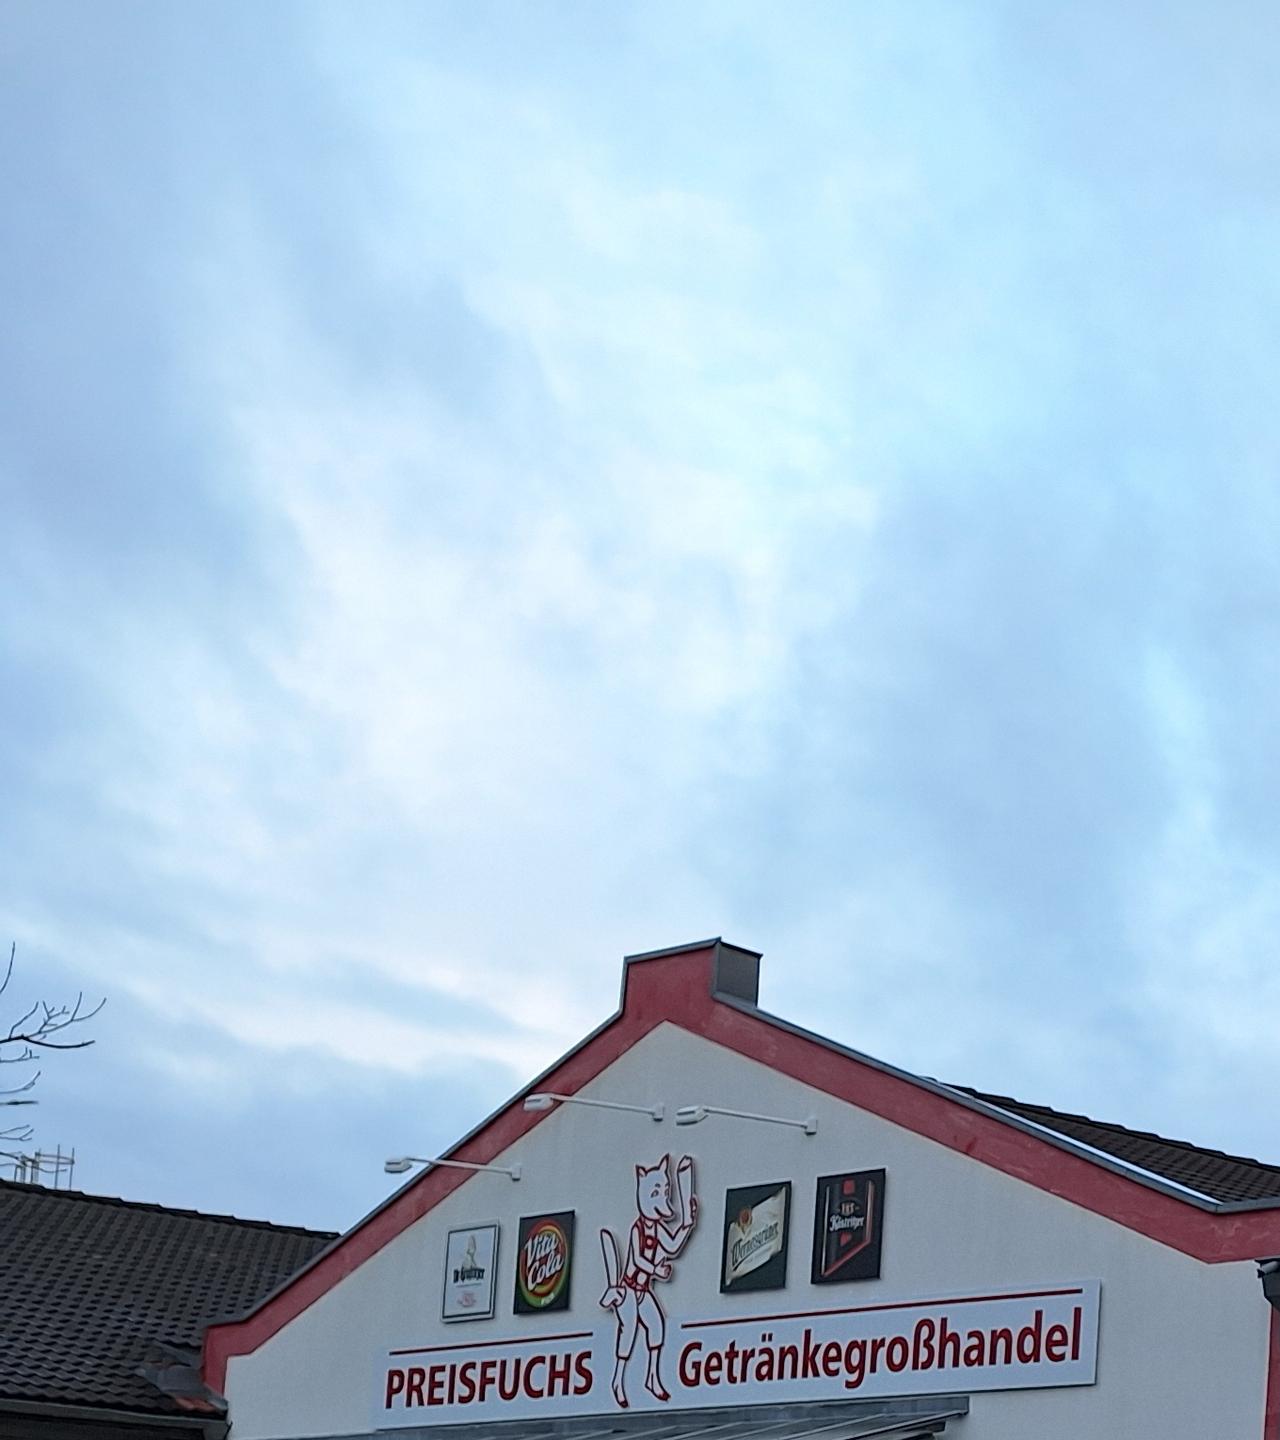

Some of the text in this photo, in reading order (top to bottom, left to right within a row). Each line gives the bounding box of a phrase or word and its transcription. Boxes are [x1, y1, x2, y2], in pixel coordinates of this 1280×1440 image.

[524, 1232, 559, 1268] Vita
[527, 1251, 563, 1291] Cola
[678, 1307, 1082, 1391] Getränkegroßhandel
[385, 1350, 593, 1409] PREISFUCHS
